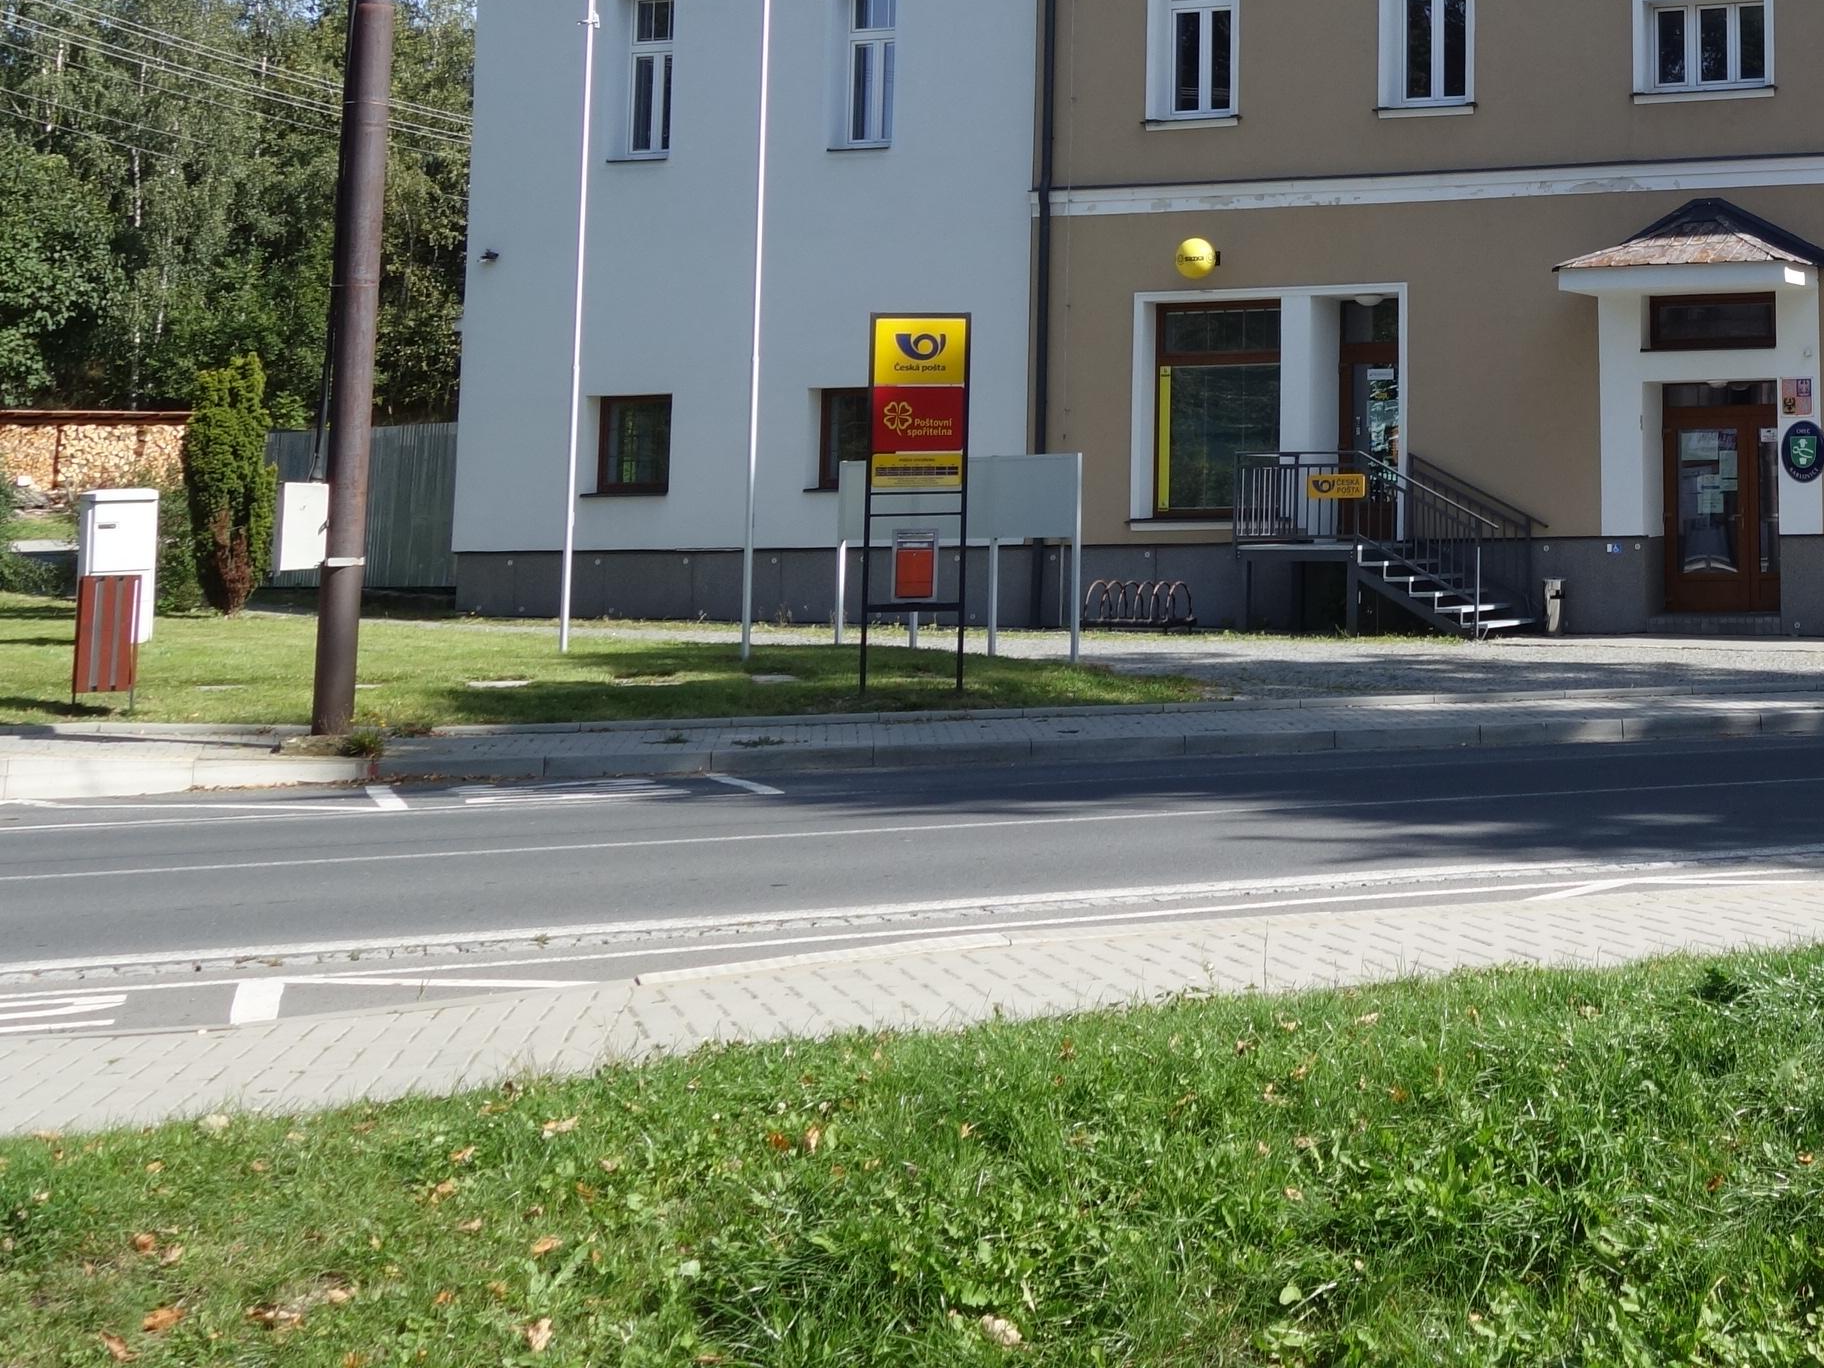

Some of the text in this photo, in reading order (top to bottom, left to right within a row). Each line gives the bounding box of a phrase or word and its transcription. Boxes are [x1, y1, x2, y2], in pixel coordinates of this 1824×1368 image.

[894, 362, 946, 372] Česká pošta
[914, 418, 952, 427] Poštovní
[907, 427, 952, 437] spořitelna
